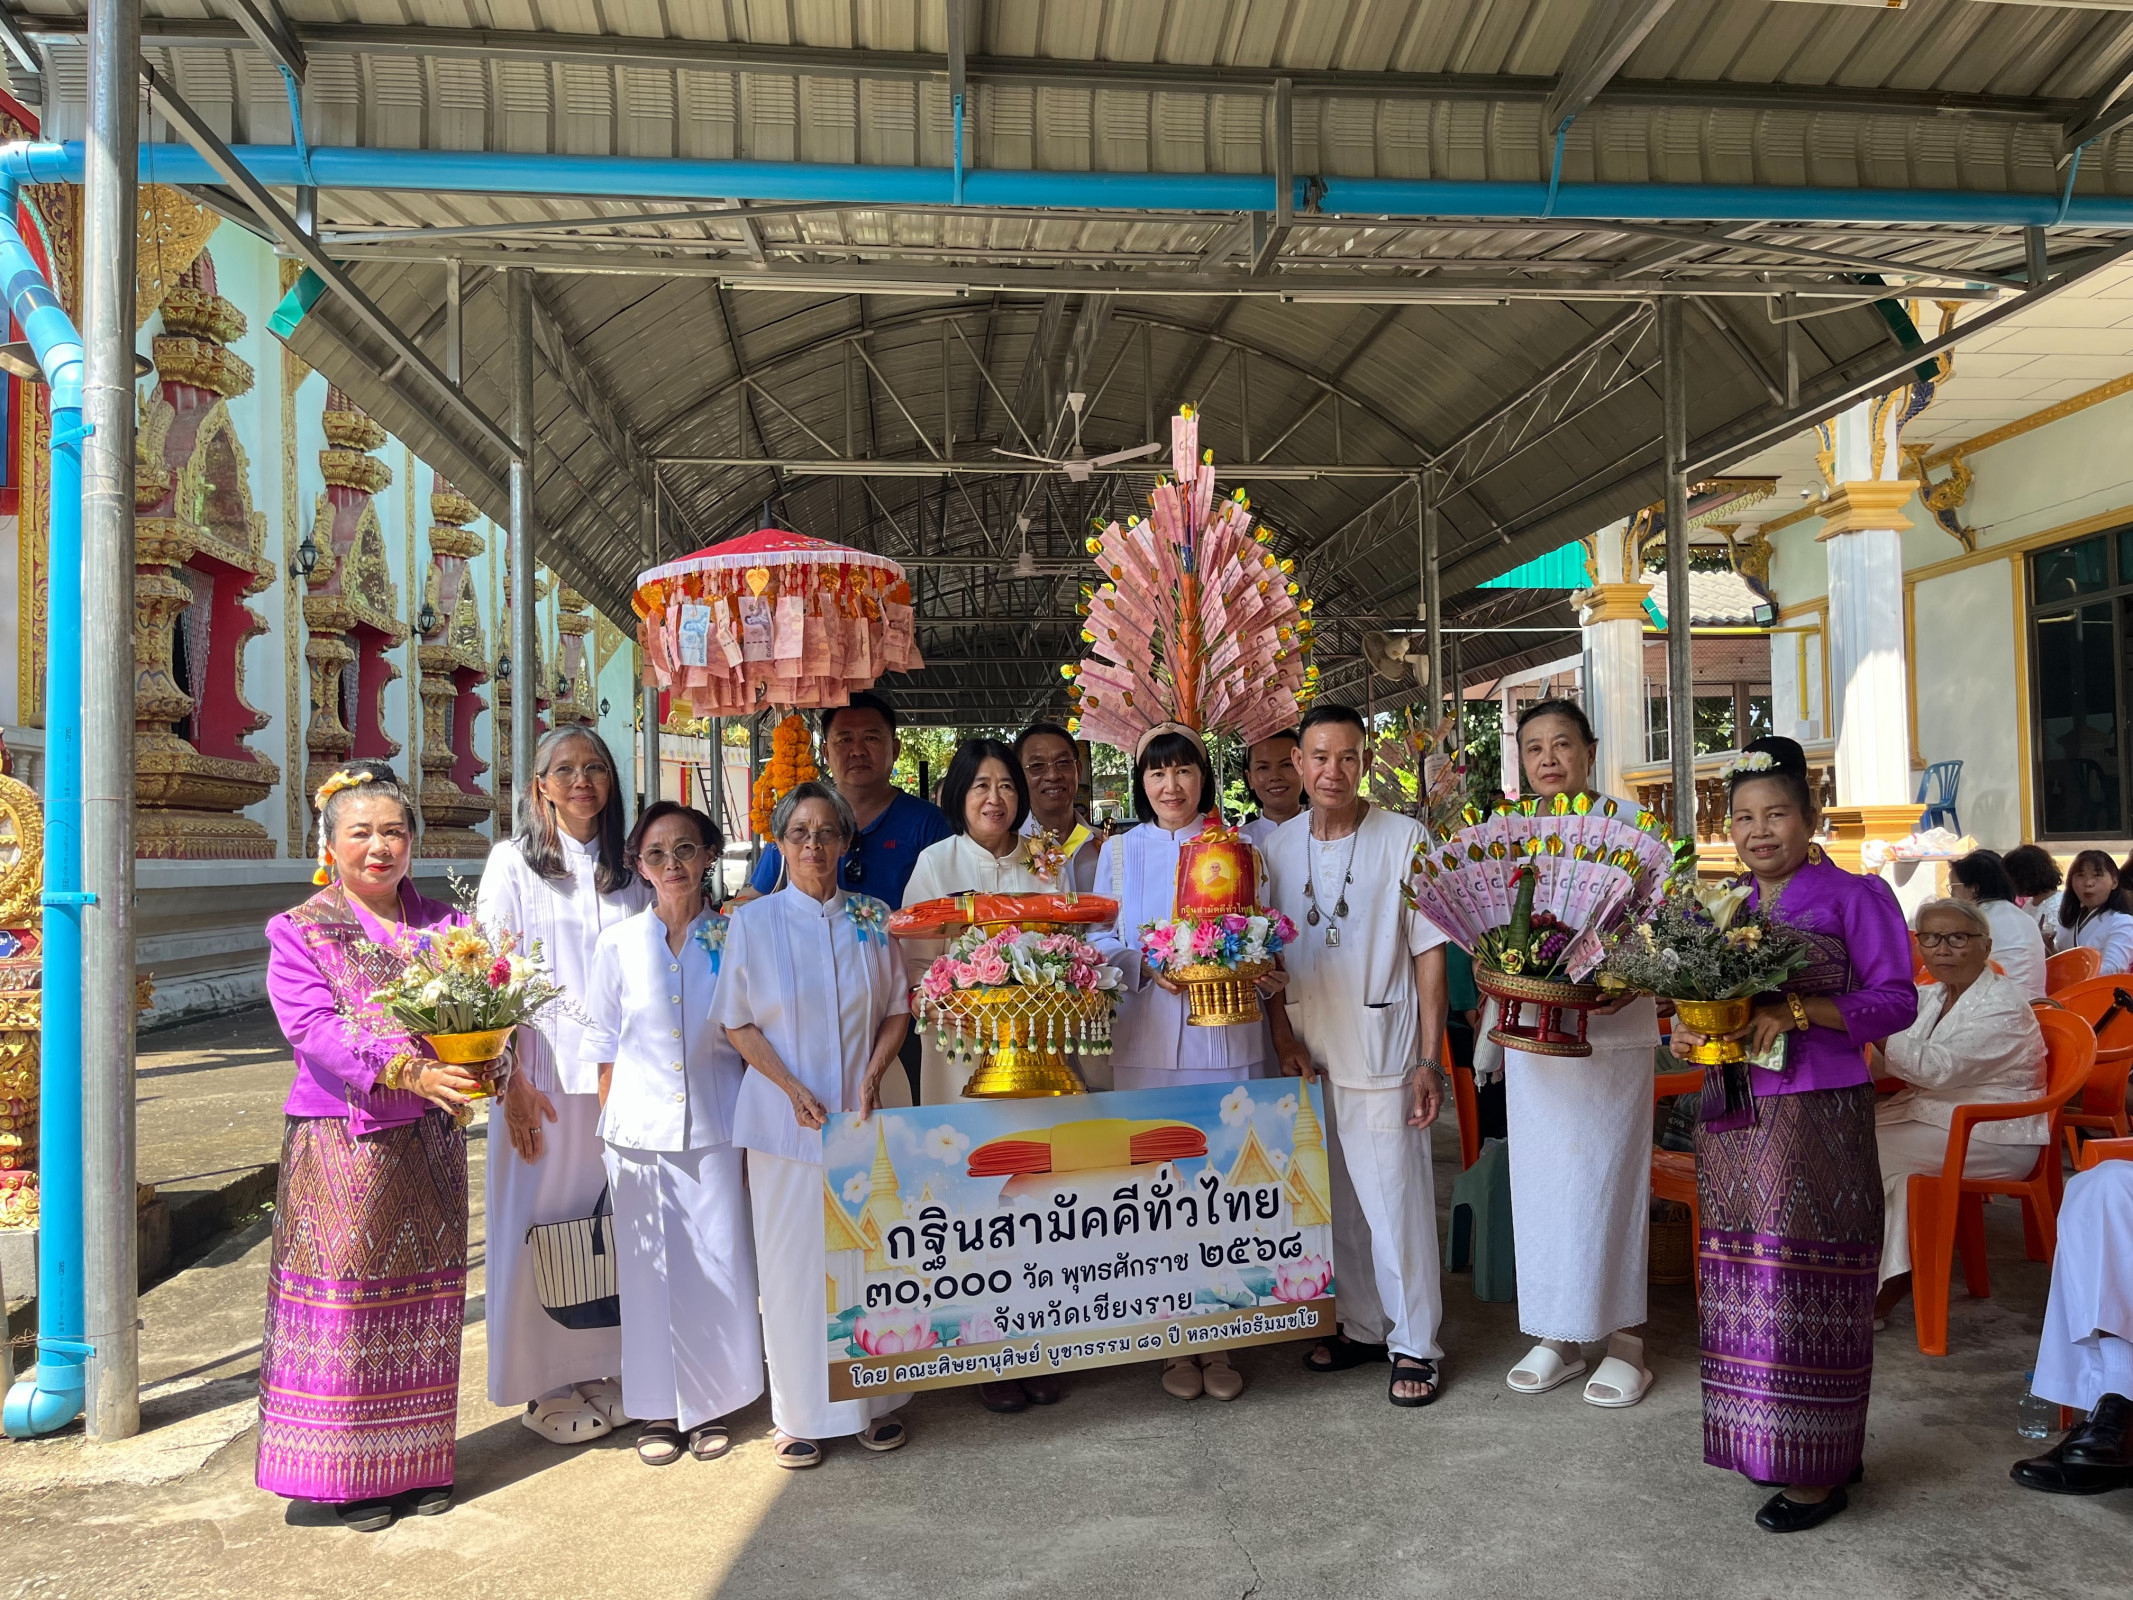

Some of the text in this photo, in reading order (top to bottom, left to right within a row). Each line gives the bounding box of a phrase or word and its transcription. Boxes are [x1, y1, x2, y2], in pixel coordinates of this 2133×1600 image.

[887, 1169, 1279, 1272] กฐินสามัคคีทั่วไทย
[866, 1231, 1303, 1308] ๓๐,๐๐๐ วัด พุทธศักราช ๒๕๖๘
[851, 1308, 1318, 1386] โดย คณะศิษยานุศิษย์ บูชาธรรม ๘๑ ปี หลวงพ่อธัมมชโย
[993, 1292, 1192, 1333] จังหวัดเชียงราย
